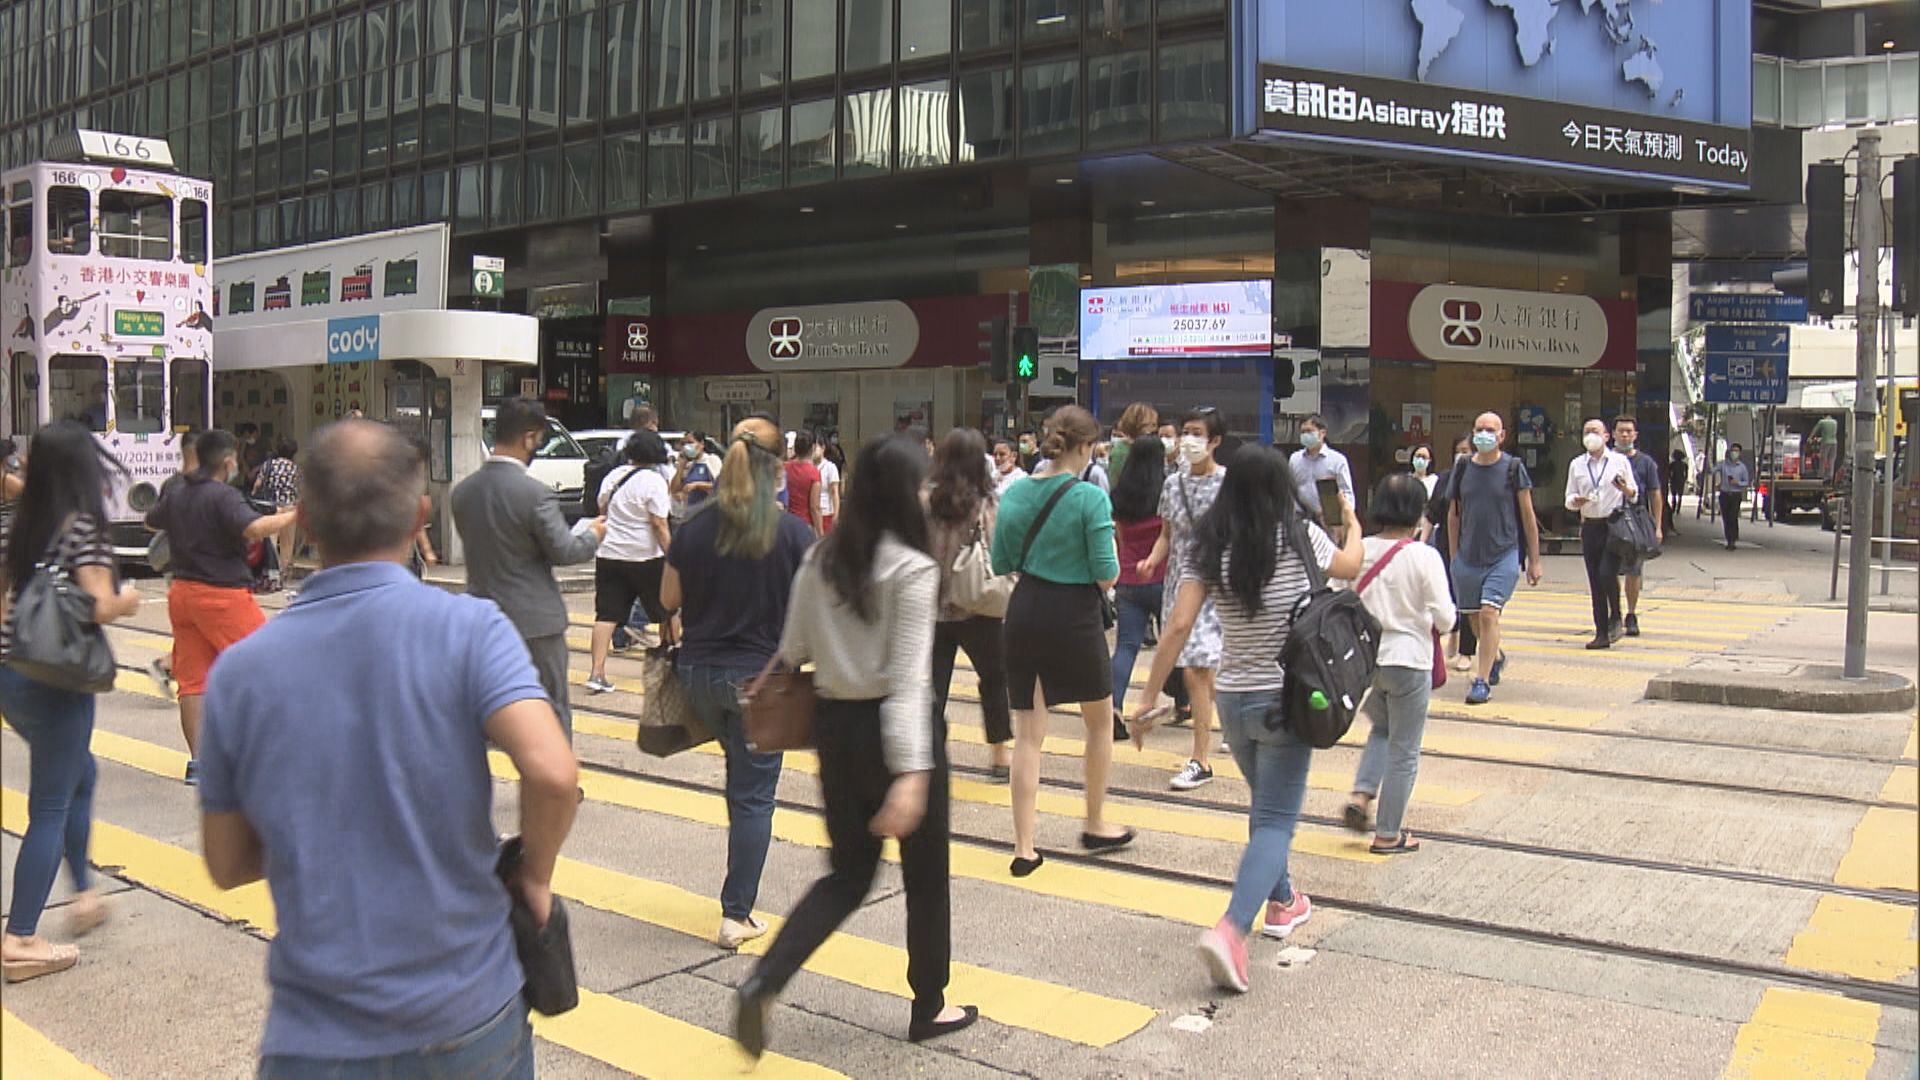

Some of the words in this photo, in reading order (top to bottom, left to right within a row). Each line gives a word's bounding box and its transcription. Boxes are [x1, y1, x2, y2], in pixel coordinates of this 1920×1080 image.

[1264, 79, 1507, 140] 資訊由Asiaray提供
[102, 135, 151, 160] 166
[1562, 120, 1683, 161] 今日天氣預測
[1696, 138, 1749, 173] Today
[52, 171, 76, 184] 166
[194, 187, 209, 200] 166
[80, 266, 190, 289] 香港小交響樂團
[1213, 302, 1230, 313] HSI
[1775, 296, 1803, 305] Station
[805, 314, 890, 338] 大新銀行
[1173, 319, 1227, 330] 25037.69
[1493, 303, 1581, 331] 大新銀行
[329, 324, 378, 355] cody
[622, 350, 656, 363] 大新銀行
